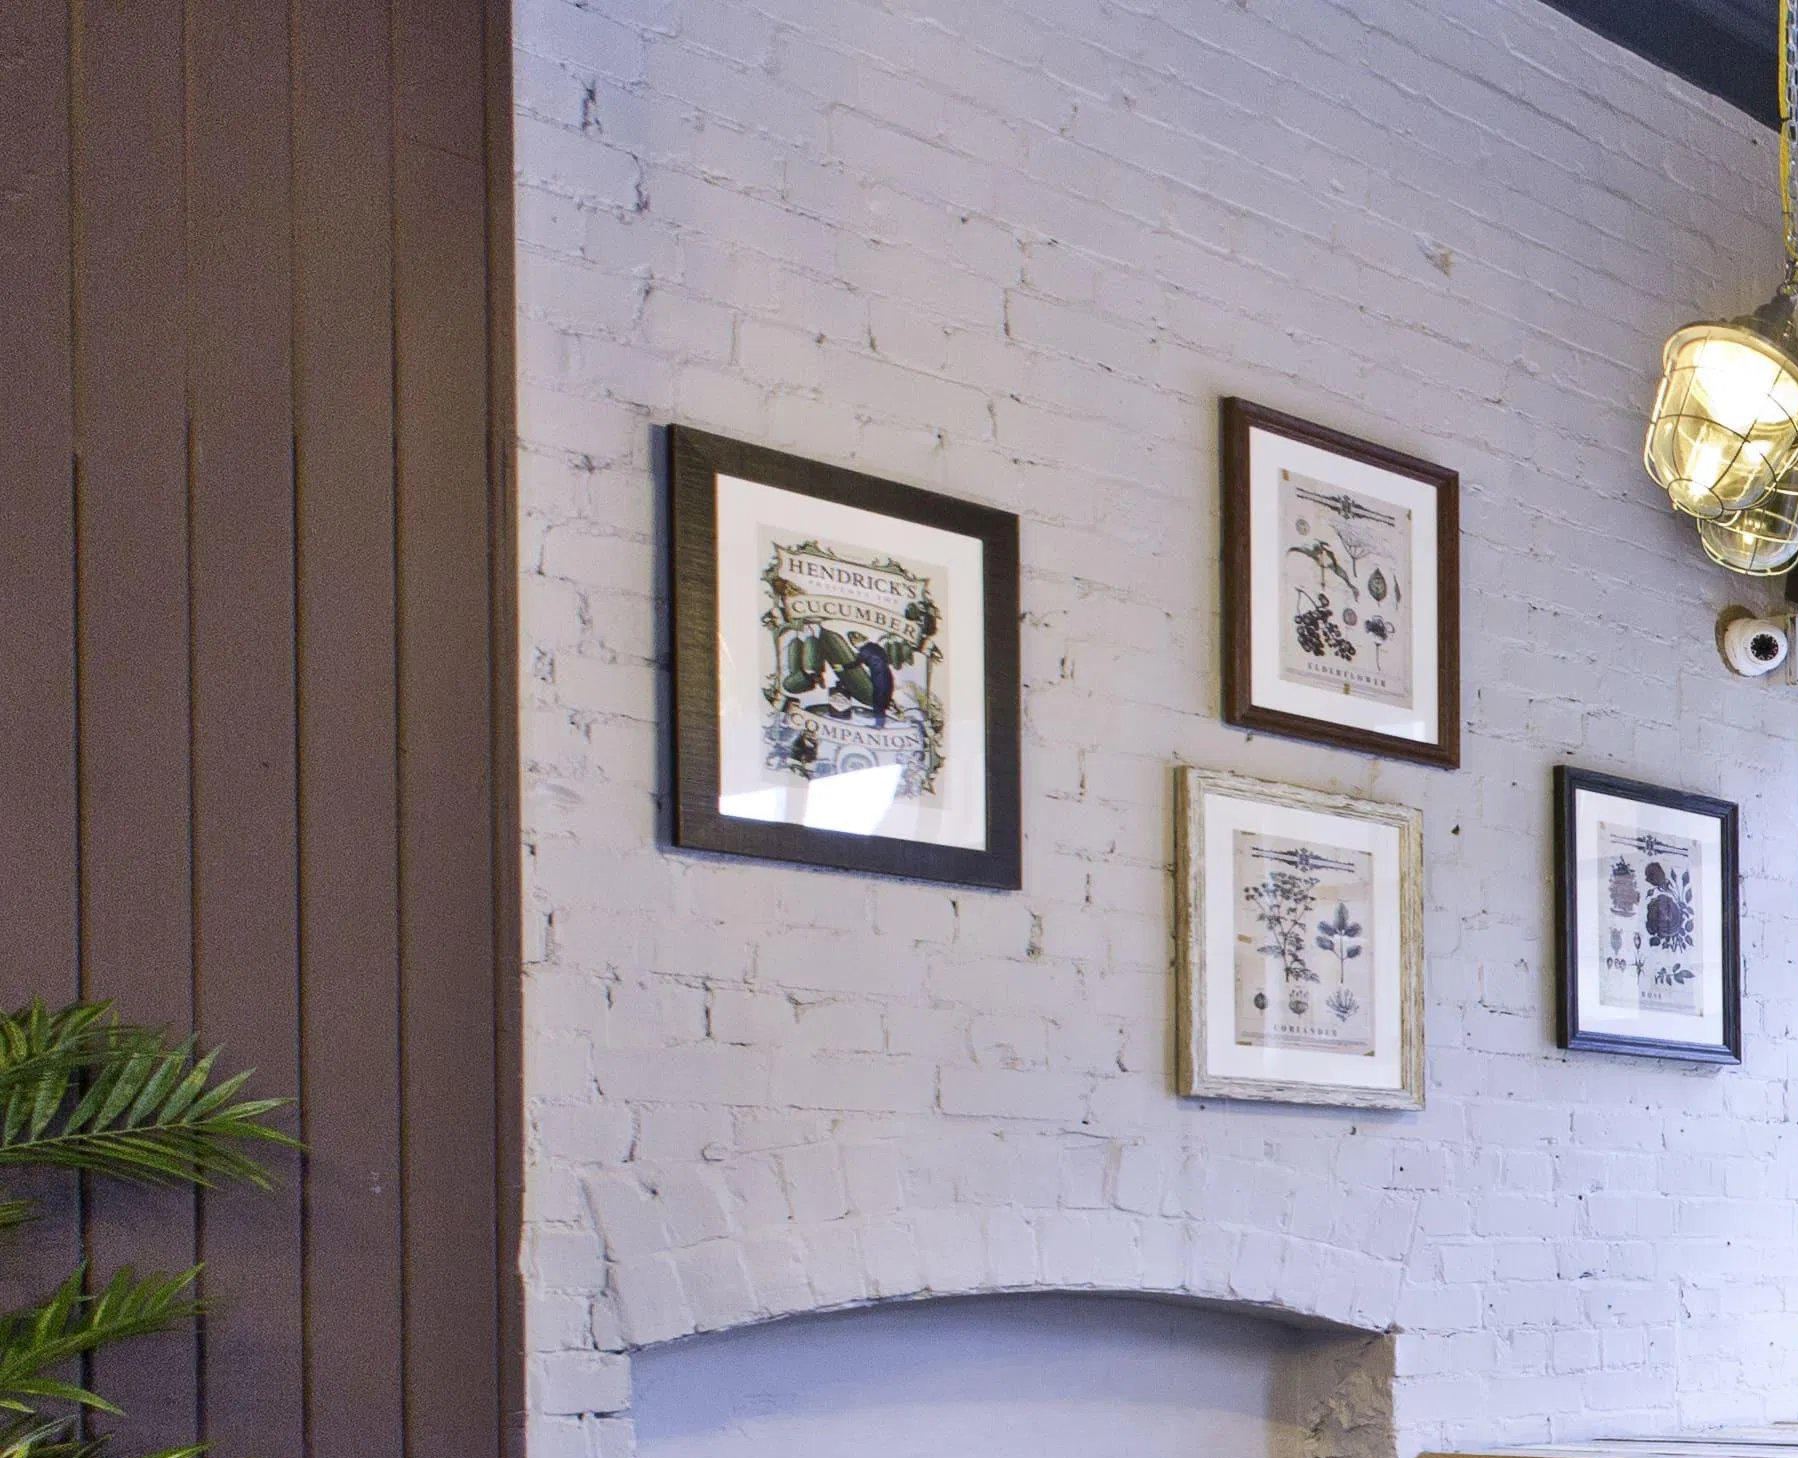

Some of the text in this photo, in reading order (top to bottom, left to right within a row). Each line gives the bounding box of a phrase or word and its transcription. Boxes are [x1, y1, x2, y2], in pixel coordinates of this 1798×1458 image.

[789, 557, 918, 599] HENDRICK'S
[792, 599, 916, 638] CUCUMBER
[790, 712, 920, 748] COMPANION
